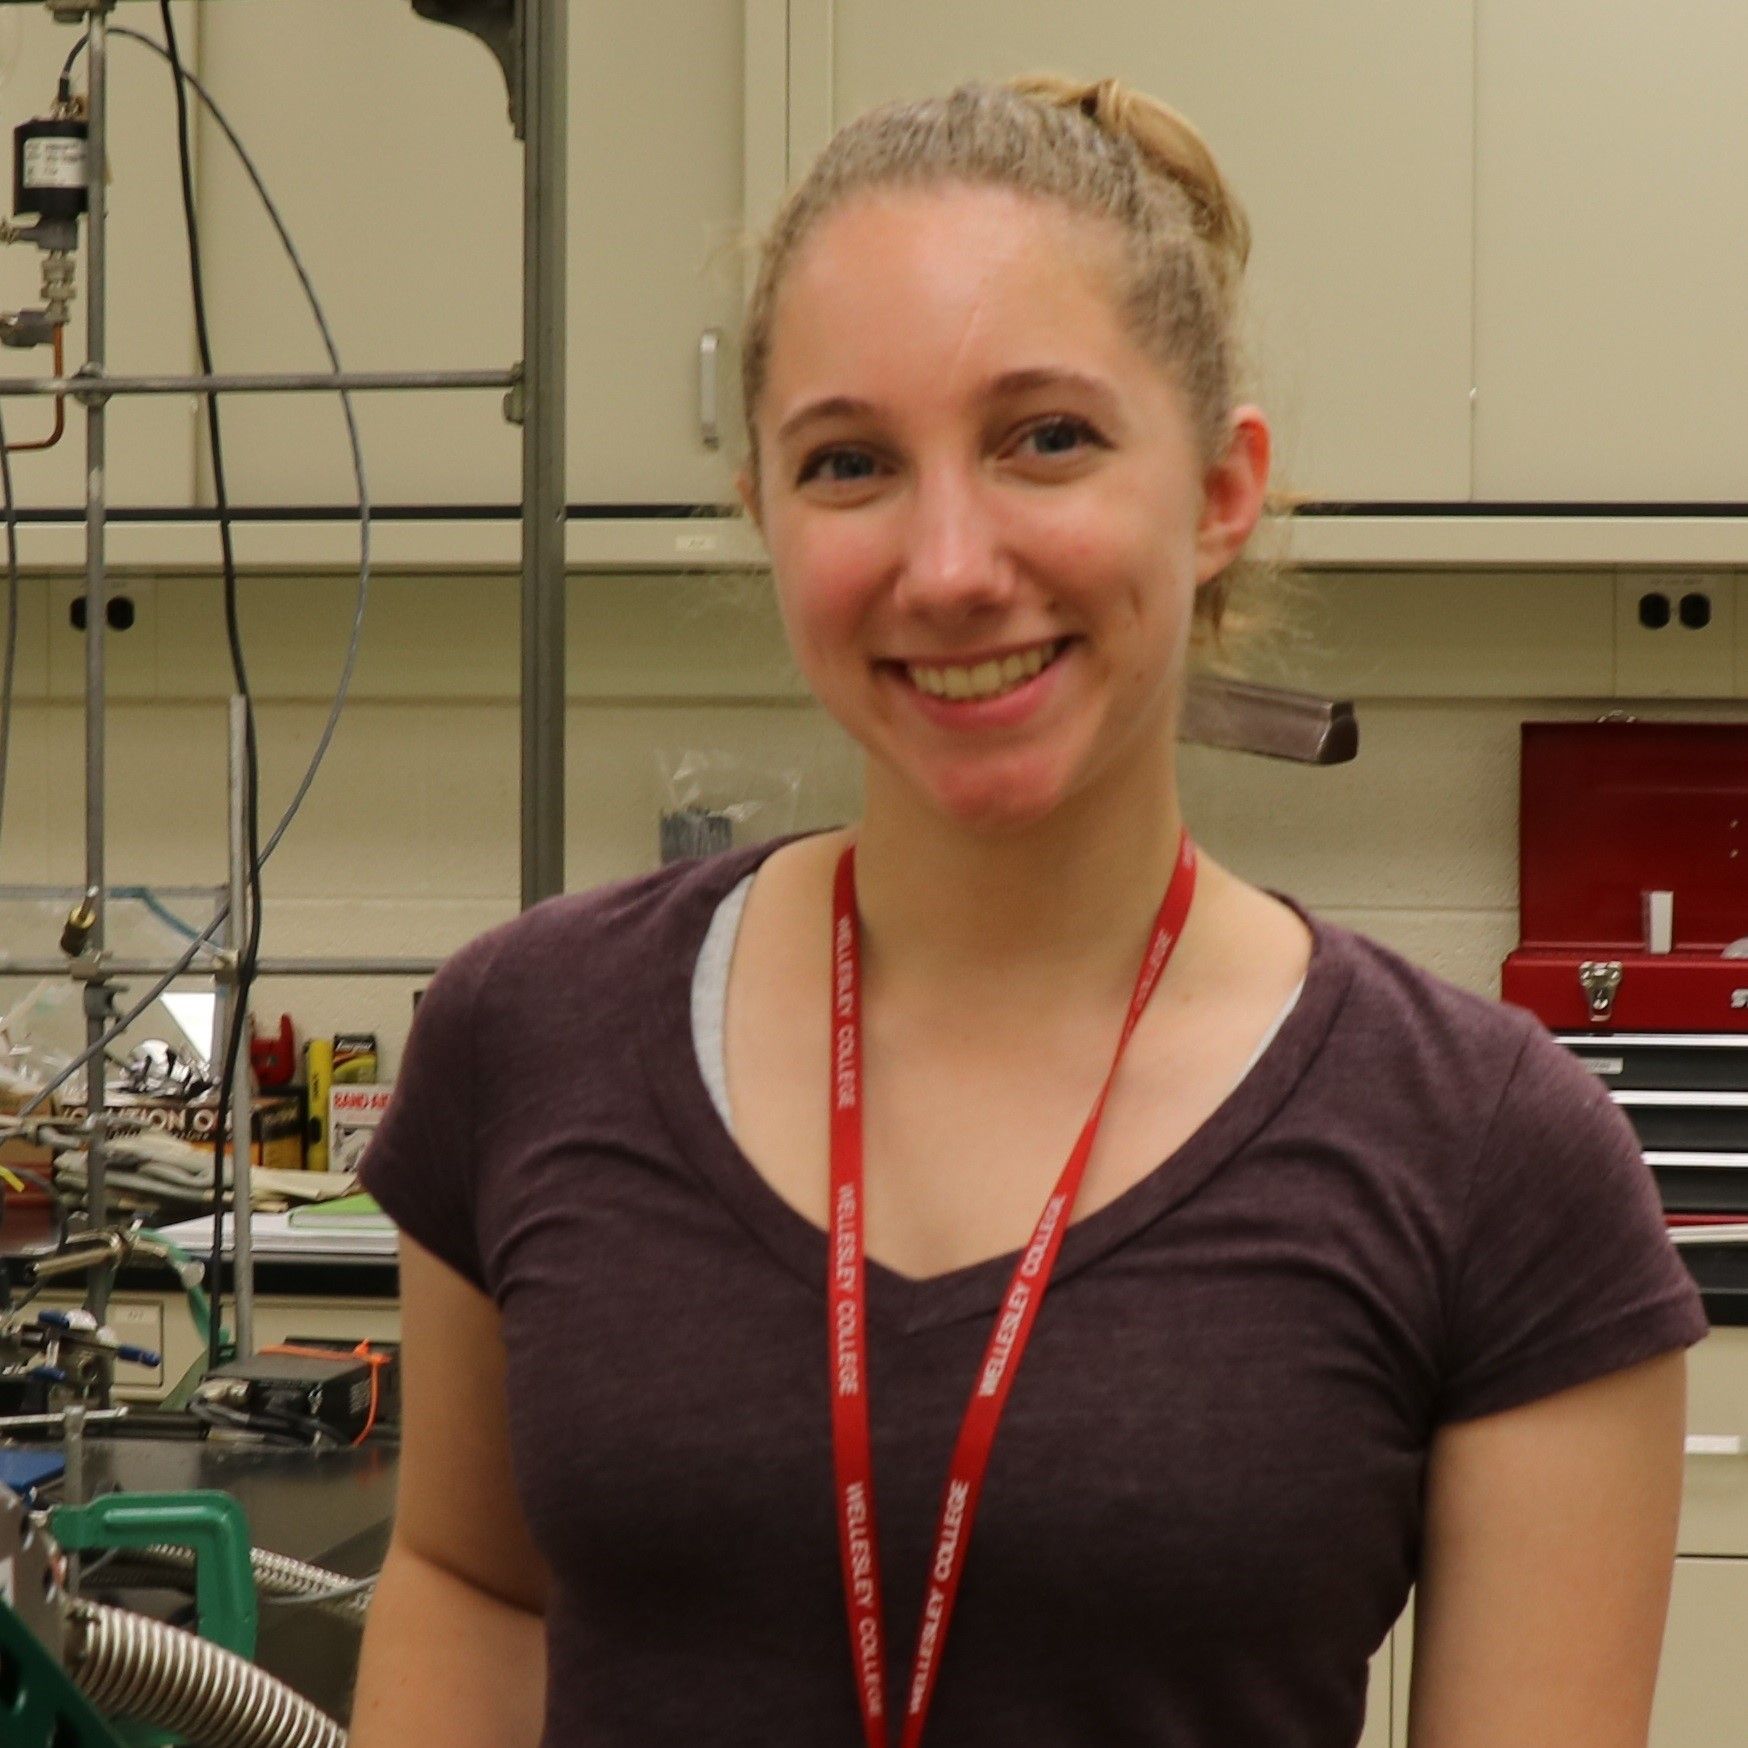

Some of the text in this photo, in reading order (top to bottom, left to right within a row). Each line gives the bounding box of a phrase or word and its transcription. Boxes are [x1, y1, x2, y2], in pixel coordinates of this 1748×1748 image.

[836, 1183, 859, 1396] WELLESLEY COLLEGE
[978, 1194, 1067, 1396] WELLESLEY COLLEGE
[846, 1481, 882, 1718] WELLESLEY COLLEGE
[908, 1479, 970, 1715] WELLESLEY COLLEGE
